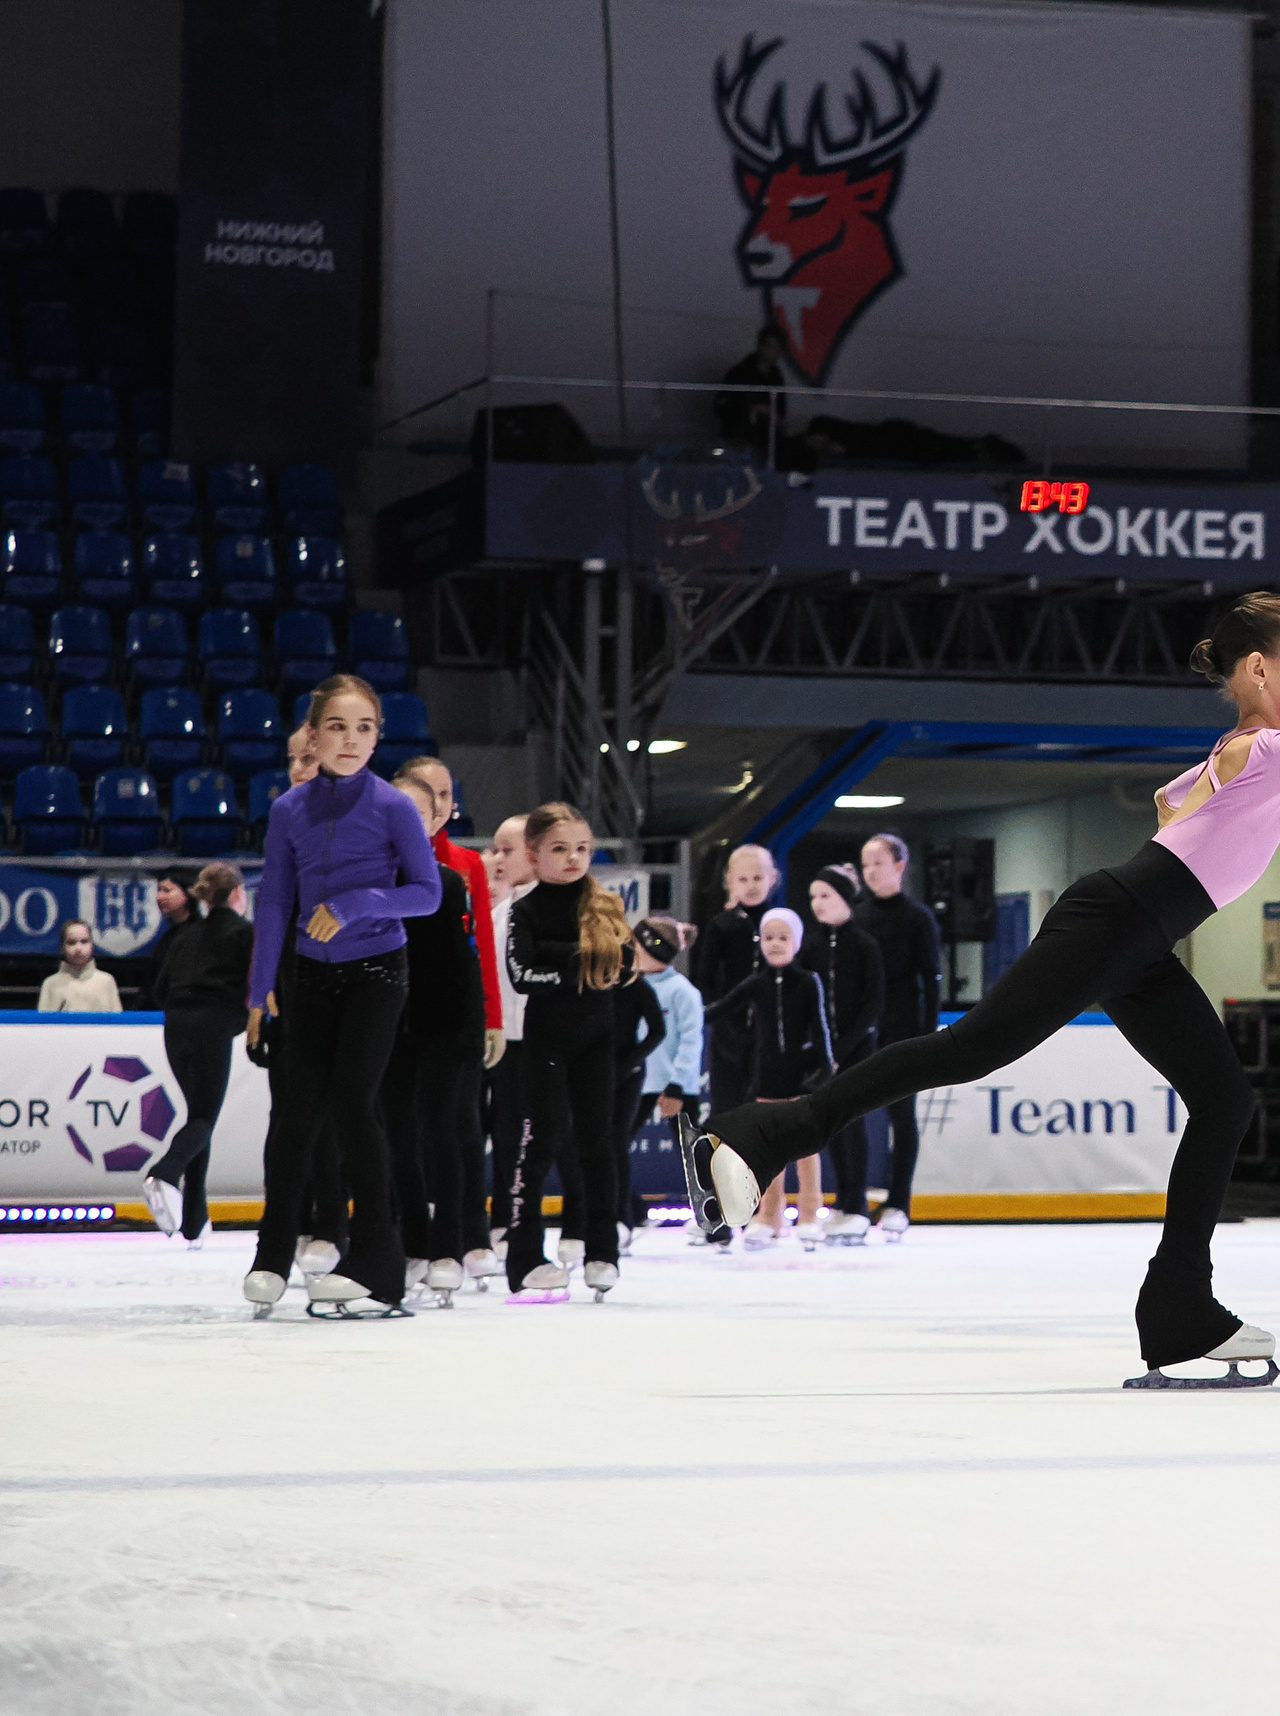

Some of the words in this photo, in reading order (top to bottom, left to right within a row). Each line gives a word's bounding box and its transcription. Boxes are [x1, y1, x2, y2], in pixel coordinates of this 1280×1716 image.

[217, 219, 325, 245] НИЖНИЙ
[204, 243, 335, 272] НОВГОРОД
[816, 496, 1007, 552] ТЕАТР
[1023, 506, 1266, 560] ХОККЕЯ
[86, 1100, 129, 1127] TV
[975, 1085, 1136, 1136] Team
